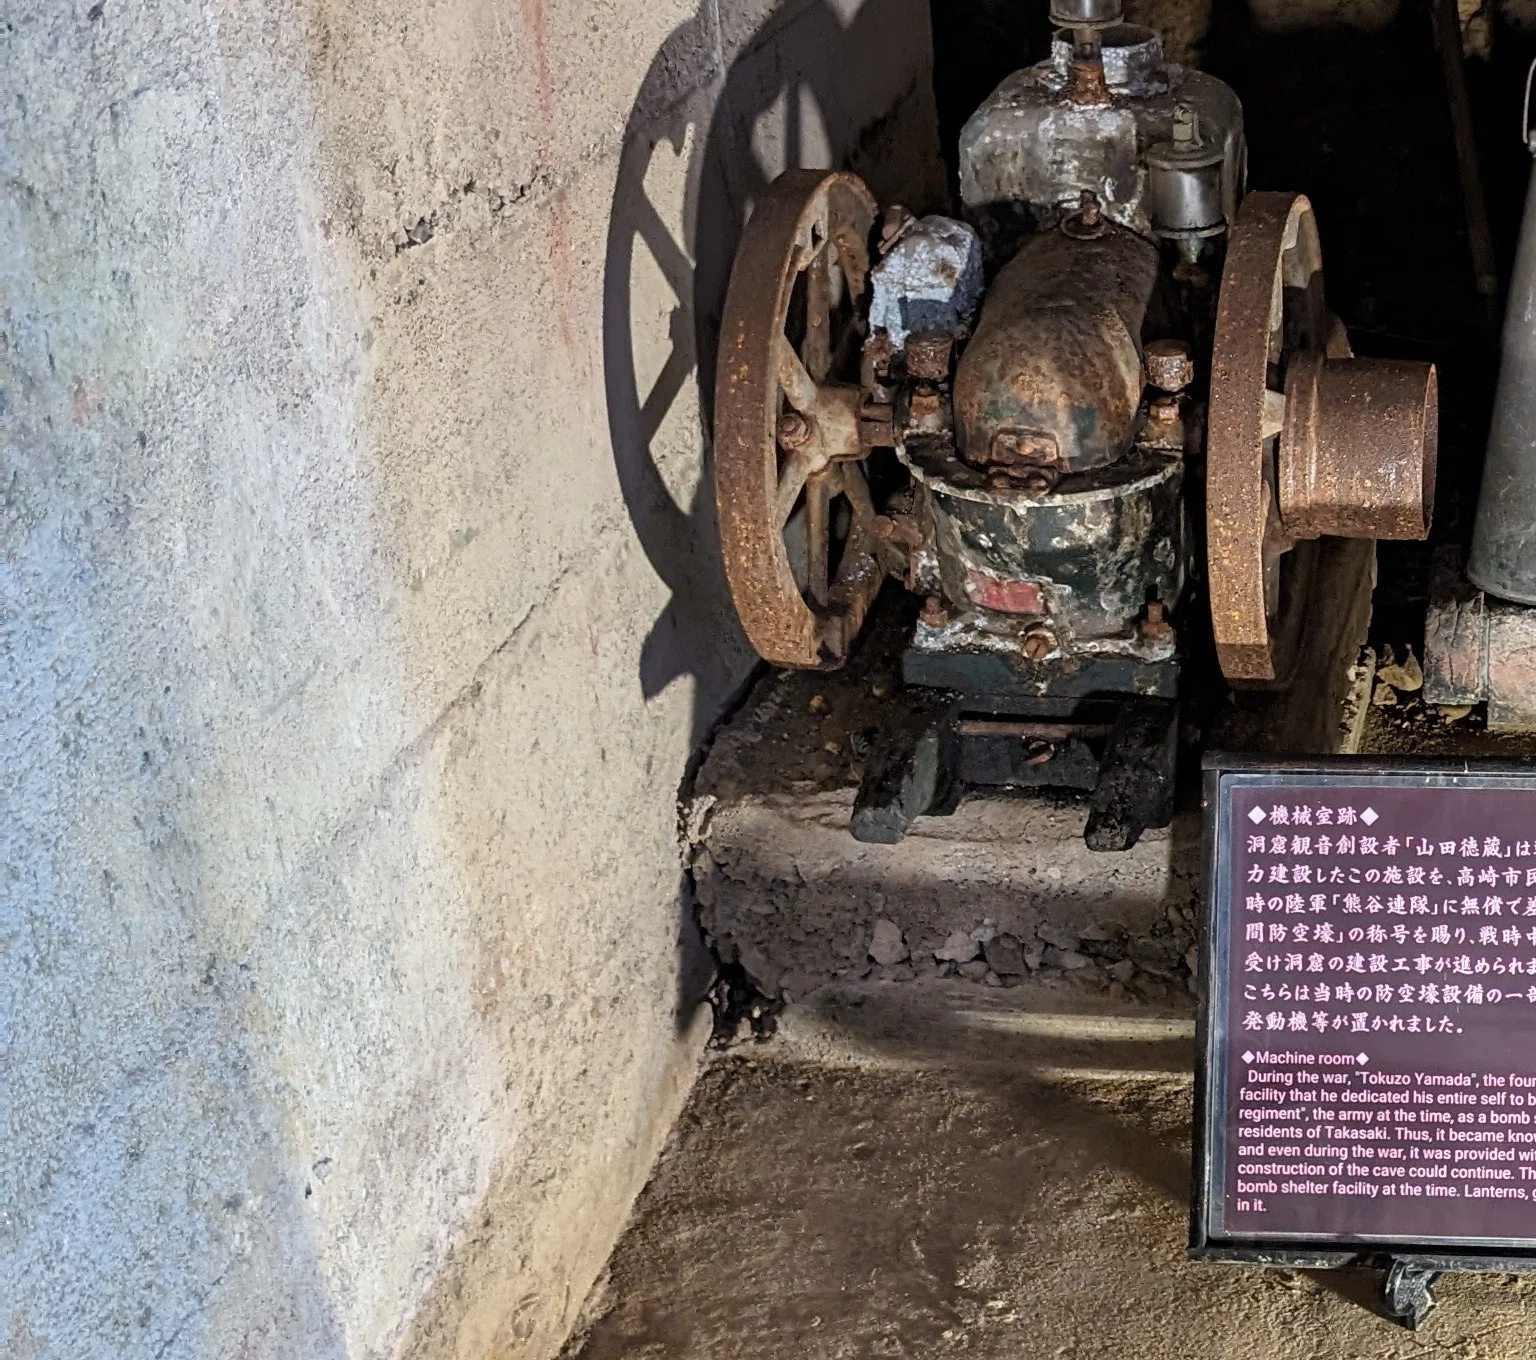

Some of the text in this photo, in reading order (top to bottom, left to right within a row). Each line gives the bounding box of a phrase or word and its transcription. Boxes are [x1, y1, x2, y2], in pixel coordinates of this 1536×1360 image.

[1256, 1051, 1355, 1065] Machine room
[1248, 1070, 1293, 1086] During
[1297, 1070, 1319, 1083] the
[1323, 1074, 1351, 1085] war,
[1483, 1074, 1505, 1086] the
[1240, 1088, 1286, 1104] facility
[1290, 1088, 1317, 1101] that
[1321, 1089, 1337, 1102] he
[1341, 1089, 1409, 1103] dedicated
[1413, 1090, 1433, 1103] his
[1437, 1092, 1477, 1104] entire
[1481, 1092, 1506, 1105] self
[1313, 1107, 1334, 1120] the
[1339, 1111, 1373, 1124] army
[1394, 1109, 1416, 1121] the
[1420, 1110, 1454, 1124] time,
[1458, 1113, 1474, 1123] as
[1491, 1110, 1530, 1124] bomb
[1239, 1125, 1303, 1138] residents
[1307, 1125, 1321, 1138] of
[1325, 1126, 1390, 1139] Takasaki.
[1395, 1127, 1432, 1142] Thus,
[1449, 1128, 1504, 1142] became
[1238, 1143, 1264, 1155] and
[1268, 1146, 1300, 1156] even
[1305, 1144, 1348, 1160] during
[1352, 1145, 1374, 1157] the
[1378, 1148, 1406, 1160] war,
[1423, 1149, 1451, 1159] was
[1455, 1148, 1514, 1162] provided
[1238, 1163, 1325, 1175] construction
[1329, 1163, 1344, 1175] of
[1347, 1163, 1369, 1176] the
[1373, 1167, 1405, 1177] cave
[1409, 1165, 1447, 1177] could
[1451, 1166, 1514, 1179] continue.
[1238, 1179, 1277, 1193] bomb
[1281, 1180, 1328, 1194] shelter
[1333, 1181, 1379, 1198] facility
[1400, 1183, 1422, 1196] the
[1425, 1184, 1460, 1196] time.
[1465, 1185, 1528, 1200] Lanterns,
[1237, 1198, 1266, 1211] in it.
